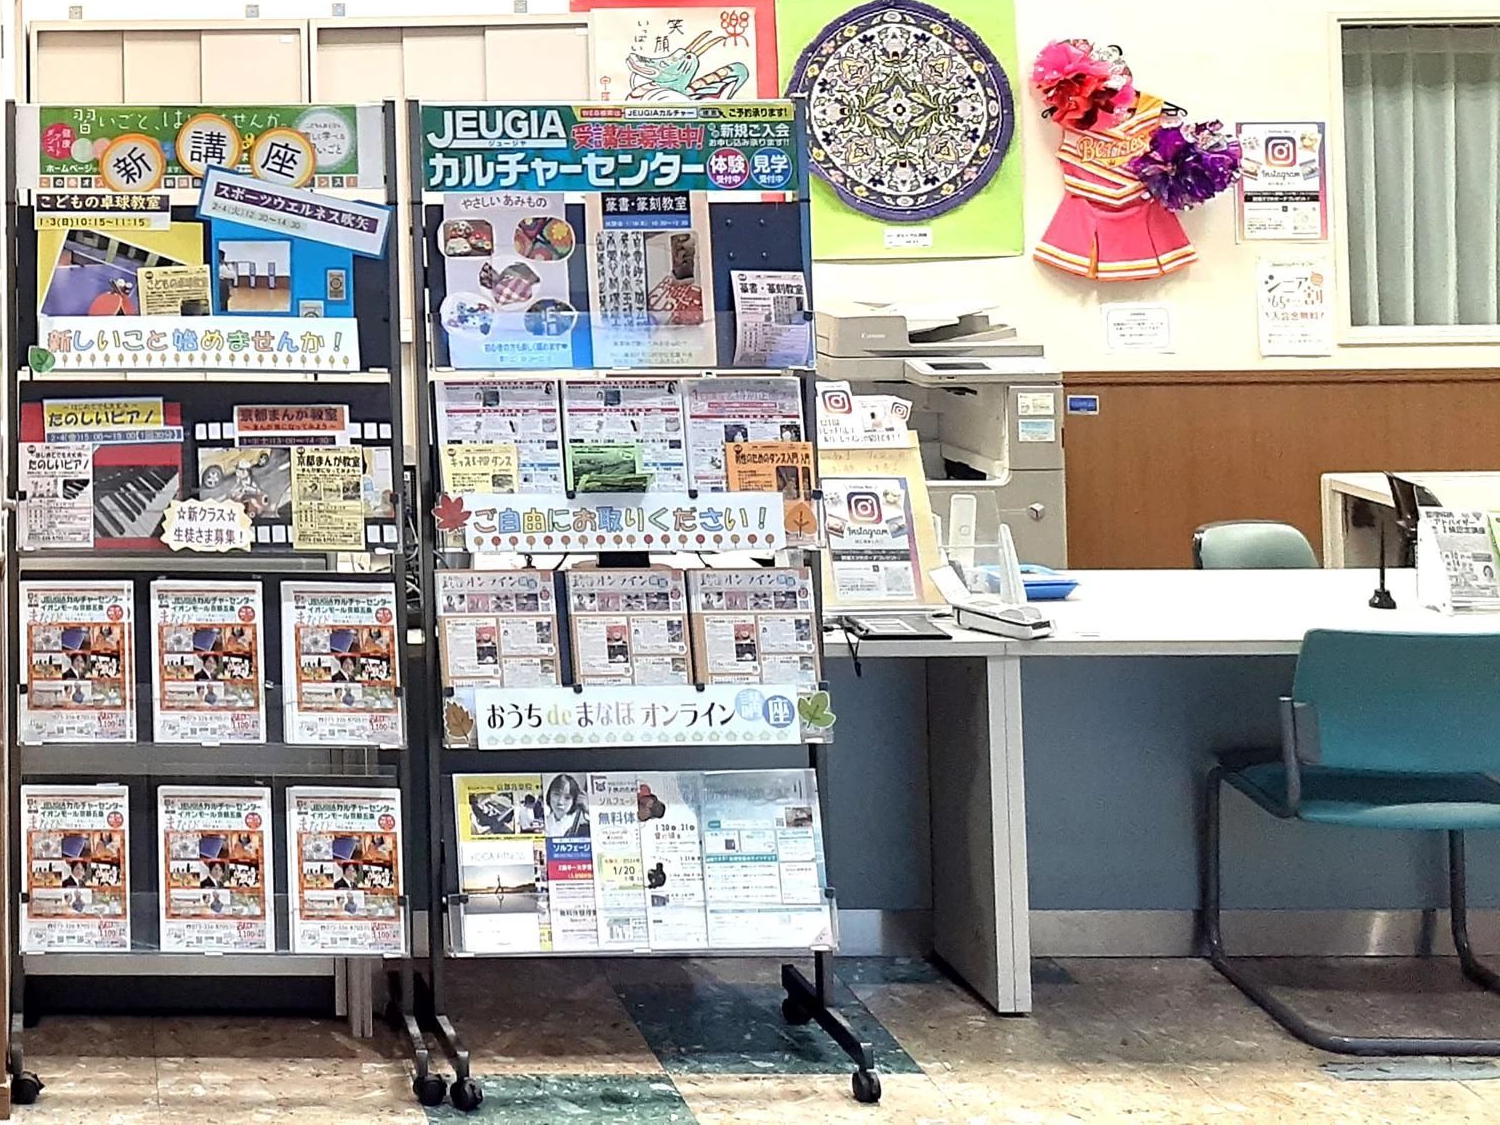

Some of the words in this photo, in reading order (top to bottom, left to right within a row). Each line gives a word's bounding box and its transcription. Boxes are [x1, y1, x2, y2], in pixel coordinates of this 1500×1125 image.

[655, 19, 684, 53] 笑顔
[627, 109, 696, 118] JEUGIAカルチャー
[728, 108, 788, 117] ご予約承ります!
[73, 108, 287, 135] 習いごと、はせんか。
[427, 109, 567, 149] JEUGIA
[571, 125, 705, 149] 受講生募集中!
[720, 123, 790, 138] 新規ご入会
[1078, 130, 1148, 163] Berries
[429, 151, 705, 188] カルチャーセンター
[709, 154, 747, 174] 体験
[753, 154, 789, 174] 見学
[716, 175, 740, 184] 受付中
[759, 175, 784, 184] 受付中
[1262, 170, 1300, 180] Instagram
[41, 195, 161, 210] こどもの卓球教室
[216, 185, 371, 230] スポーツウエルネス吹矢
[461, 197, 500, 209] やさしい
[503, 195, 547, 208] あみもの
[605, 196, 688, 211] 篆書・篆刻教室
[1264, 275, 1309, 293] シニア
[1271, 311, 1319, 320] 入会金無料
[48, 329, 343, 353] 新しいこと始めませんか!
[49, 410, 153, 426] たのしいピアノ
[240, 409, 338, 422] 京都まんが教室
[28, 459, 89, 470] たのしいピアノ
[297, 454, 361, 467] 京都まんが教室
[473, 506, 766, 534] ご自由にお取りください!
[174, 528, 244, 545] 生徒さま募集!
[847, 526, 889, 540] Instagram
[613, 866, 635, 875] 1/20
